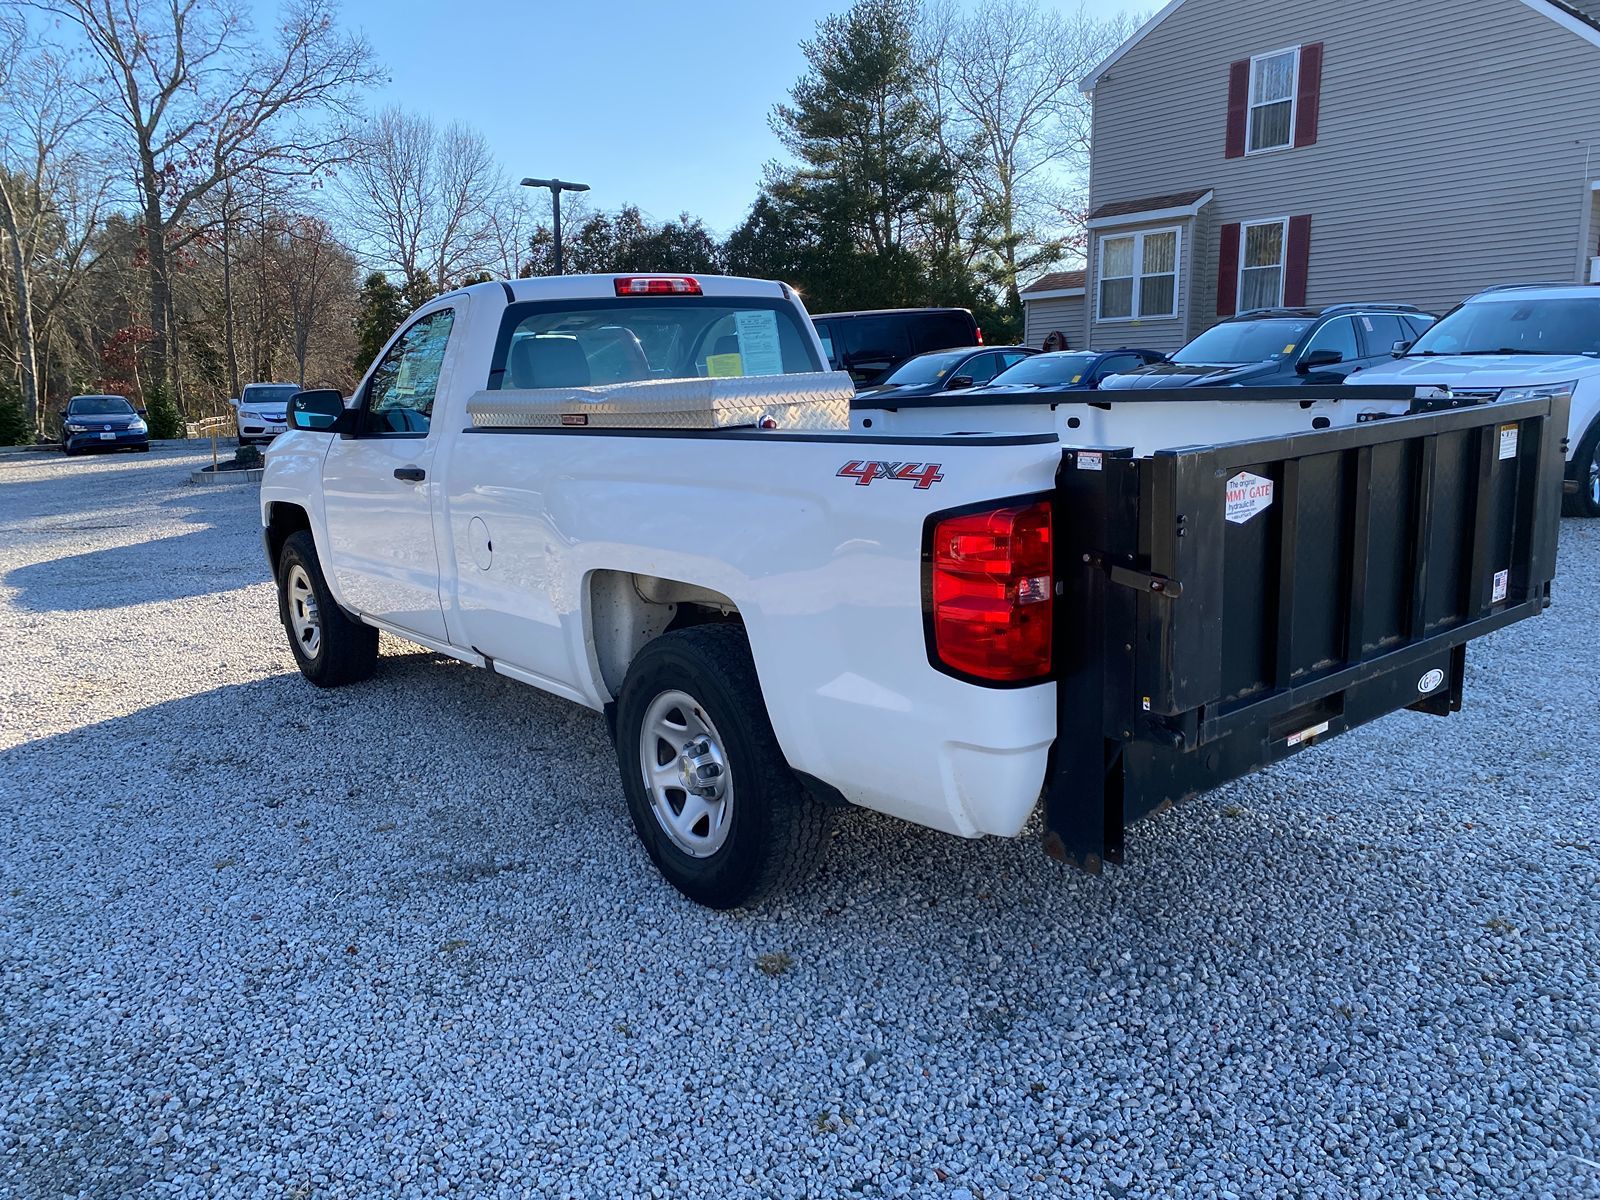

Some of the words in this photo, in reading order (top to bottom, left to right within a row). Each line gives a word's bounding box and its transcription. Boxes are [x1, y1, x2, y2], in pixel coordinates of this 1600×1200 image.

[1230, 481, 1239, 489] The
[1226, 489, 1247, 503] MMY
[1249, 484, 1270, 499] GATE
